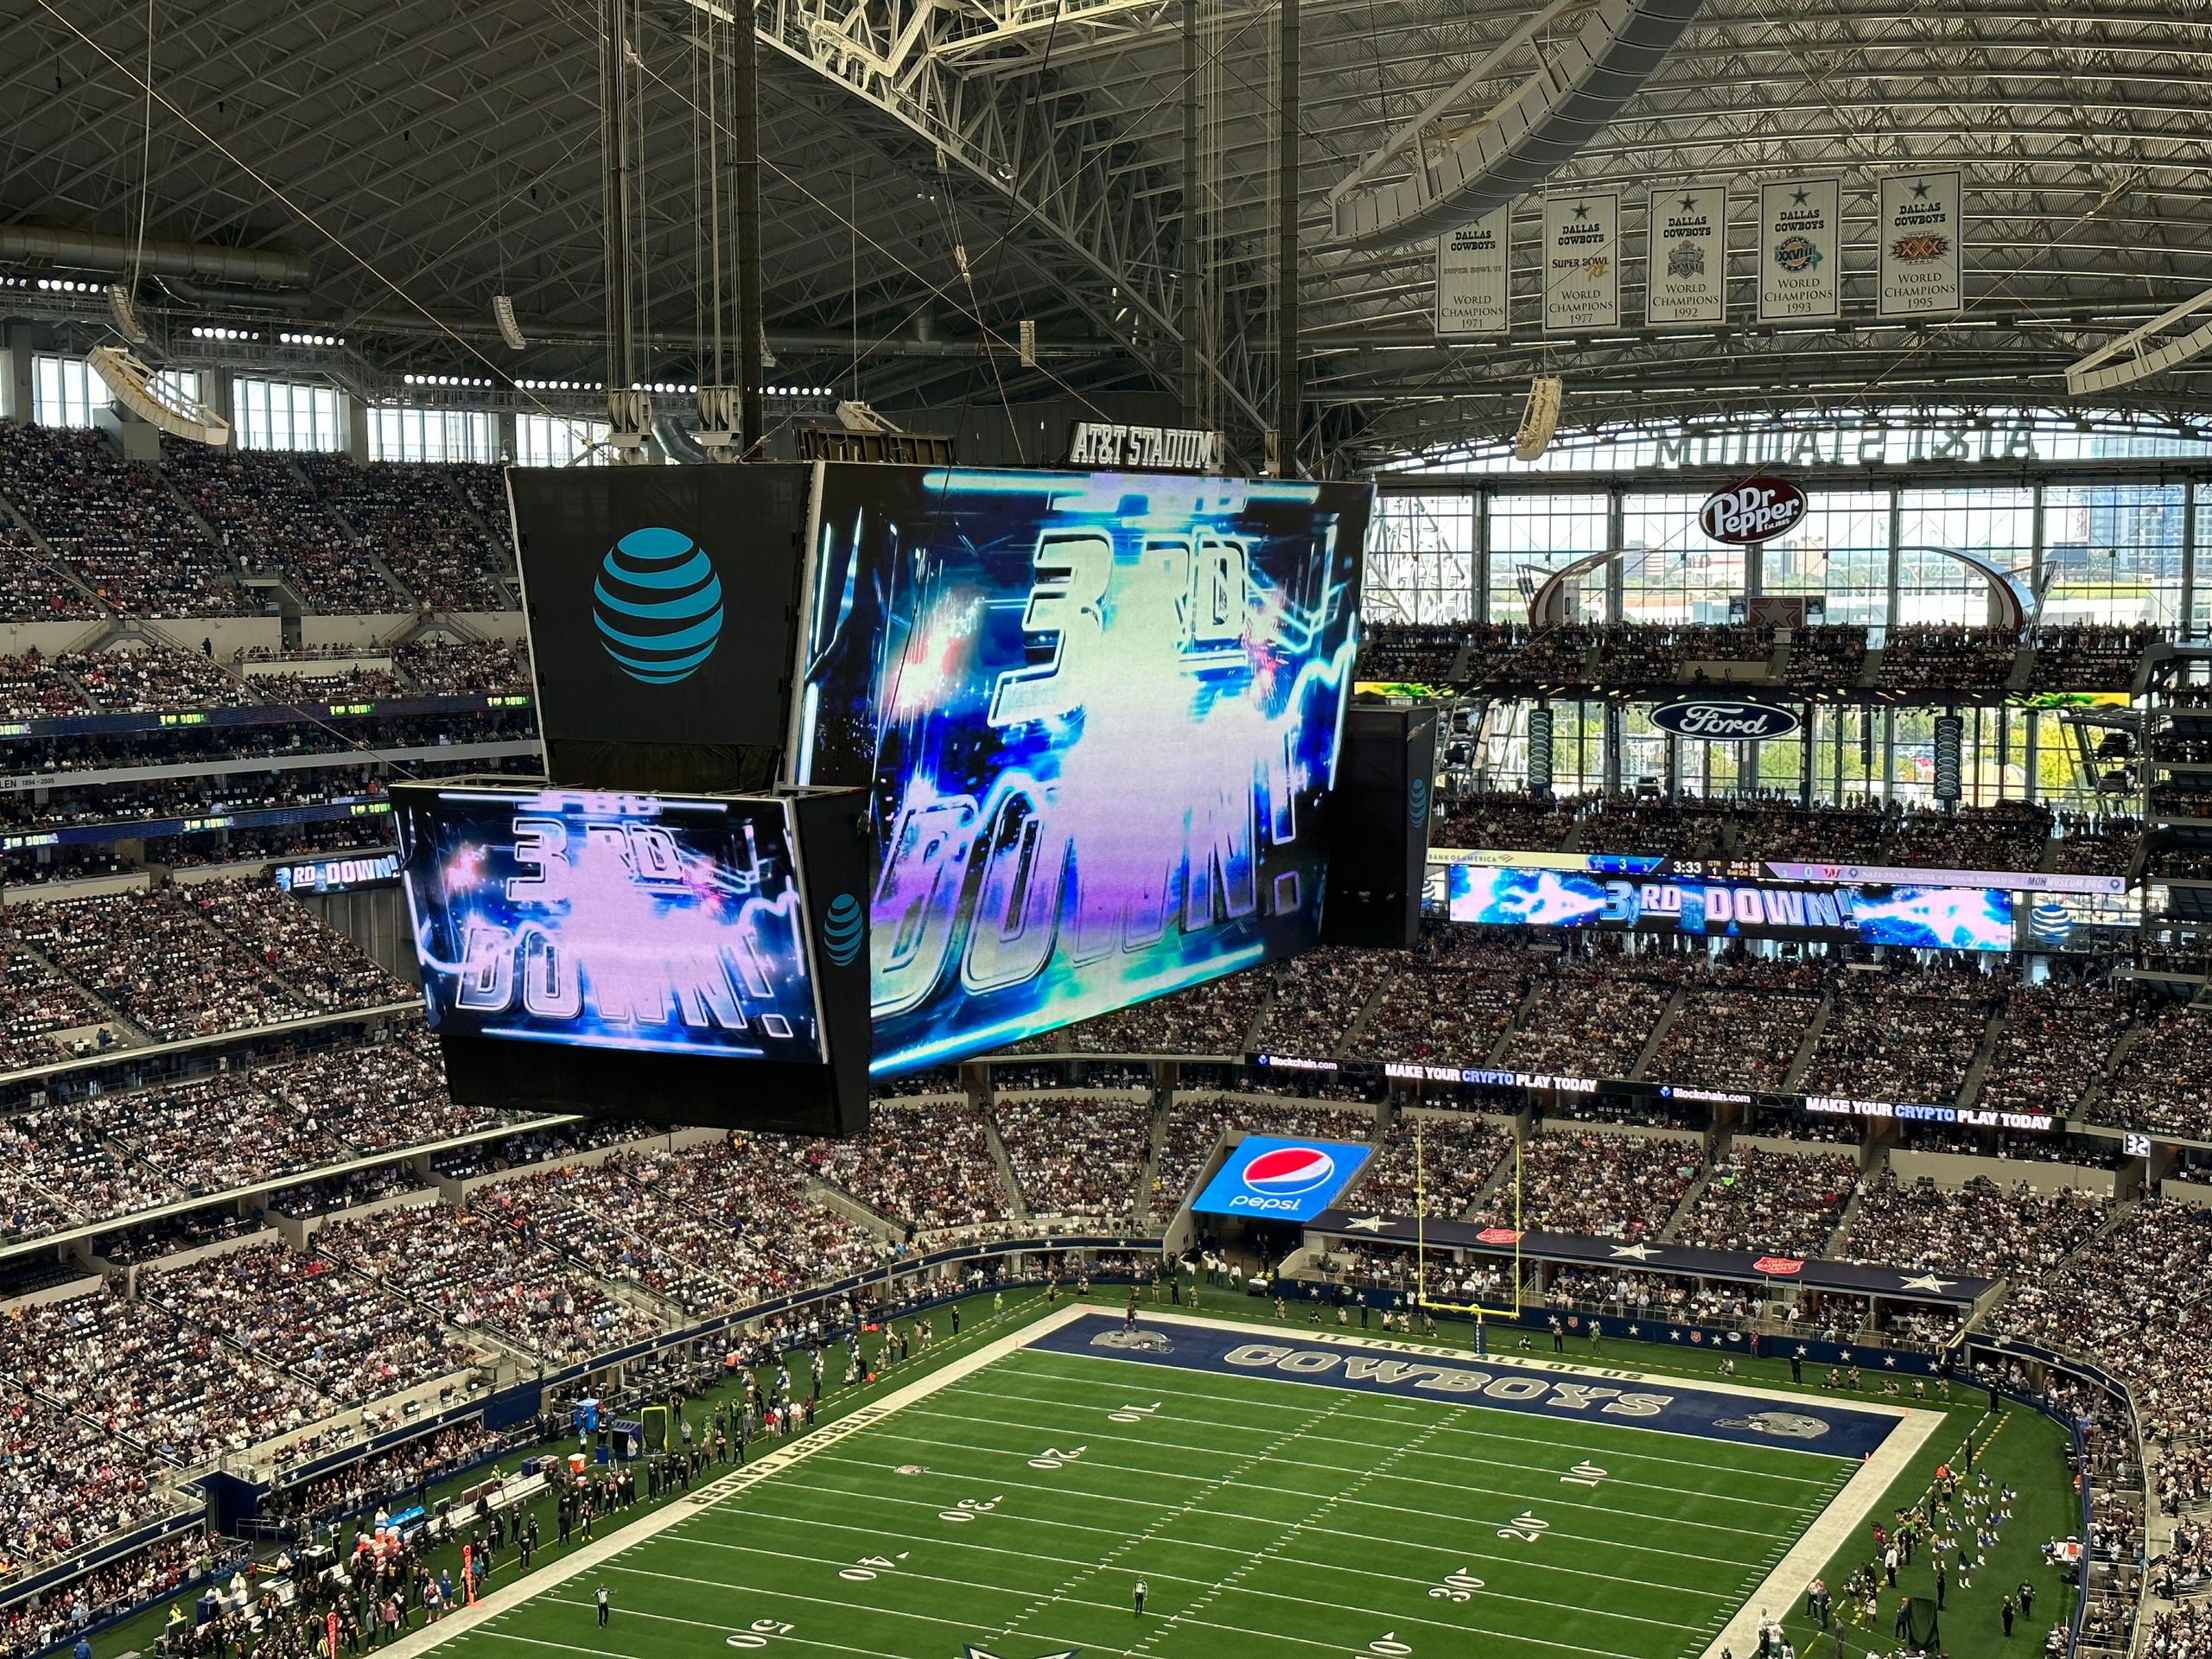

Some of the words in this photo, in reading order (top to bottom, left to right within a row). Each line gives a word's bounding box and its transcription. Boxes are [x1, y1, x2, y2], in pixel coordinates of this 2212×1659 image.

[1780, 209, 1820, 221] DALLAS
[1899, 202, 1941, 215] DALLAS
[1668, 215, 1707, 227] DALLAS
[1775, 219, 1825, 232] COWBOYS
[1894, 213, 1946, 226] COWBOYS
[1455, 230, 1491, 240] DALLAS
[1562, 223, 1599, 235] DALLAS
[1663, 226, 1712, 238] COWBOYS
[1451, 241, 1496, 251] COWBOYS
[1558, 234, 1605, 245] COWBOYS
[1552, 258, 1580, 269] SUPER
[1777, 277, 1821, 289] WORLD
[1897, 272, 1942, 283] WORLD
[1561, 289, 1601, 301] WORLD
[1665, 283, 1707, 294] WORLD
[1885, 284, 1955, 298] CHAMPIONS
[1453, 296, 1491, 305] WORLD
[1653, 295, 1719, 307] CHAMPIONS
[1764, 289, 1833, 302] CHAMPIONS
[1549, 301, 1613, 314] CHAMPIONS
[1786, 302, 1812, 314] 1993
[1908, 298, 1933, 309] 1995
[1441, 307, 1503, 318] CHAMPIONS
[1569, 313, 1593, 324] 1977
[1675, 308, 1698, 318] 1992
[1461, 318, 1484, 328] 1971
[1070, 422, 1127, 464] AT&T
[1127, 426, 1213, 468] STADIUM
[1738, 487, 1776, 513] Dr
[1702, 493, 1800, 537] Pepper
[1680, 706, 1768, 734] Ford
[1618, 858, 1627, 870] 3
[1674, 861, 1701, 874] 3:33
[1731, 861, 1743, 869] 3rd
[276, 866, 315, 893] 3RD
[326, 854, 401, 885] DOWN!
[1804, 867, 1813, 877] 0
[1599, 880, 1682, 922] 3RD
[1703, 886, 1859, 931] DOWN!
[1269, 1056, 1338, 1071] Blockchain.com
[1385, 1064, 1424, 1079] MAKE
[1425, 1068, 1460, 1081] YOUR
[1462, 1070, 1515, 1085] CRYPTO
[1516, 1073, 1552, 1089] PLAY
[1553, 1077, 1598, 1092] TODAY
[1673, 1088, 1751, 1103] Blockchain.com
[1806, 1096, 1850, 1113] MAKE
[1852, 1101, 1893, 1116] YOUR
[1895, 1104, 1955, 1122] CRYPTO
[1957, 1109, 2000, 1125] PLAY
[2001, 1113, 2051, 1129] TODAY
[2127, 1135, 2148, 1154] 32
[1230, 1196, 1301, 1211] pepsi
[1315, 1333, 1346, 1342] IT
[1362, 1339, 1459, 1357] TAKES
[1470, 1353, 1529, 1367] ALL
[1546, 1363, 1588, 1372] OF
[1600, 1370, 1644, 1380] US
[1224, 1344, 1675, 1417] COWBOYS
[1107, 1403, 1156, 1422] 10
[776, 1407, 891, 1460] INTERCEPT
[1027, 1447, 1080, 1469] 20
[1559, 1465, 1607, 1487] 10
[683, 1461, 780, 1505] CANCER
[938, 1497, 995, 1522] 30
[1497, 1517, 1550, 1542] 20
[838, 1555, 895, 1580] 40
[1428, 1575, 1485, 1602] 30
[726, 1618, 795, 1649] 50
